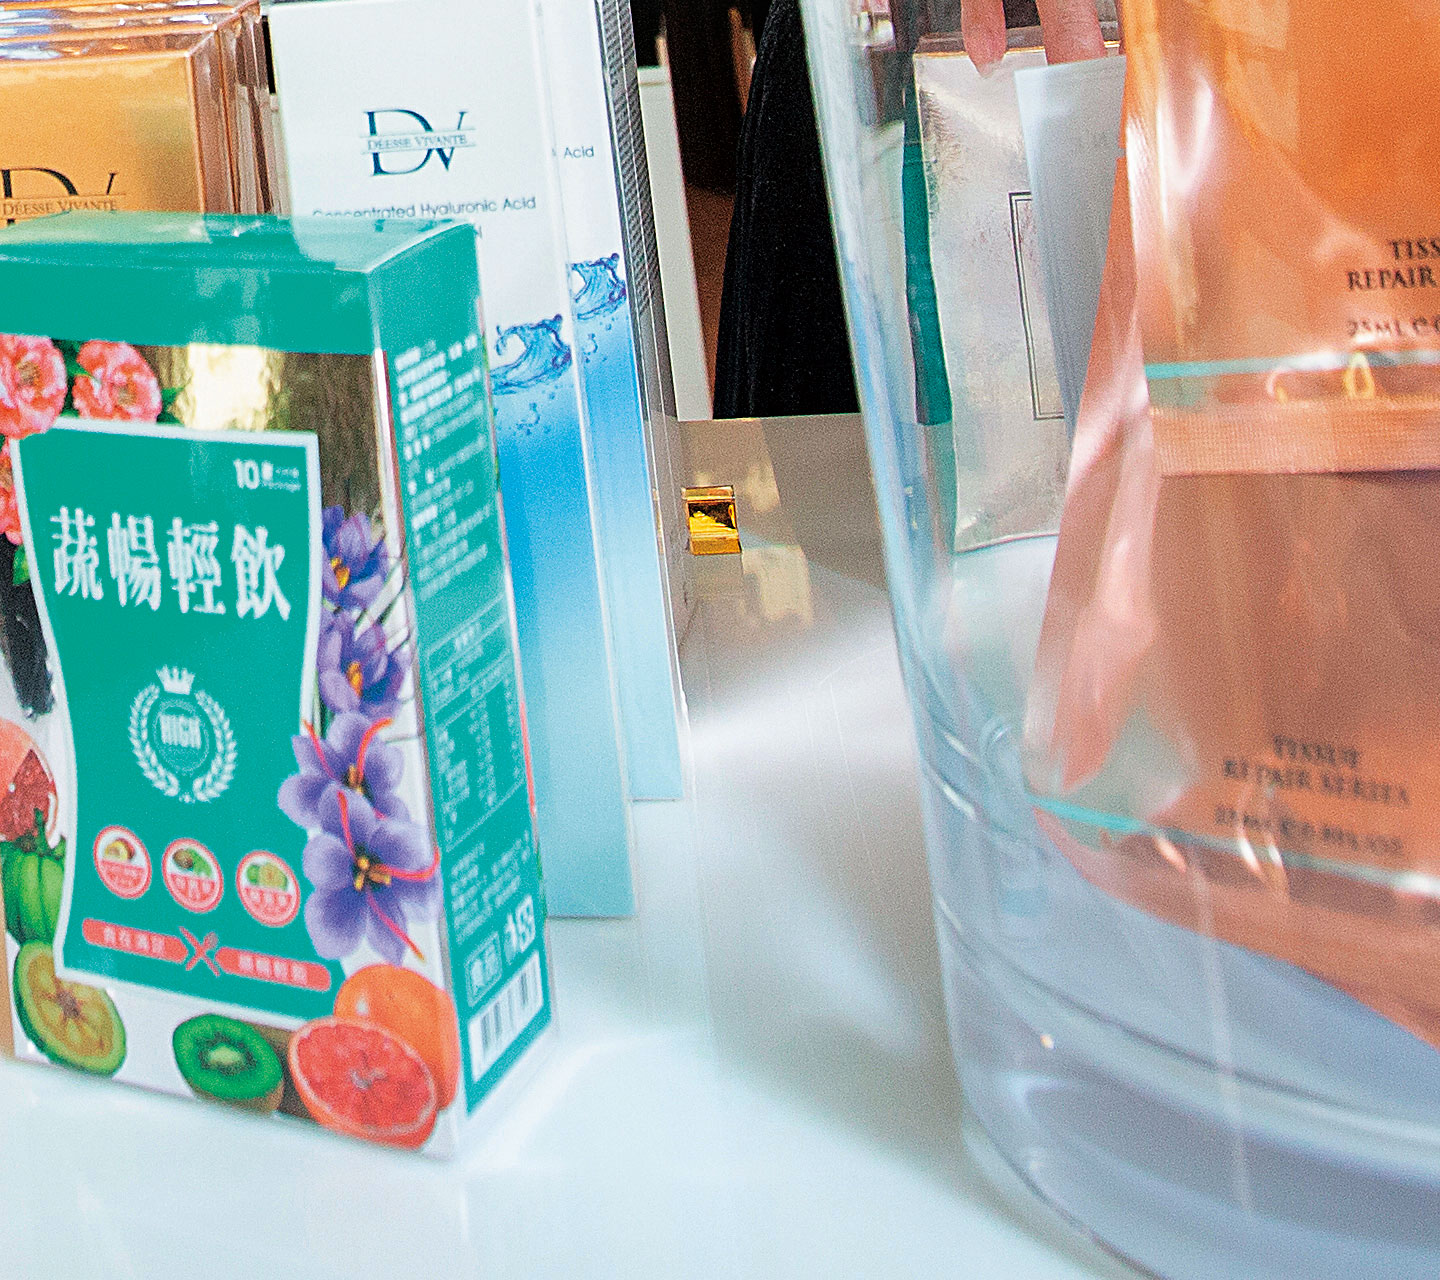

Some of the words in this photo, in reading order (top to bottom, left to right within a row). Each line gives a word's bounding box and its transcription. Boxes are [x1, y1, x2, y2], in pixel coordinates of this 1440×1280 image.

[363, 109, 468, 177] DV
[563, 146, 595, 159] Acid
[420, 199, 498, 220] Hyaluronic
[503, 196, 537, 211] Acid
[1346, 265, 1438, 291] REPAIR
[233, 458, 261, 490] 10
[50, 505, 292, 622] 蔬暢輕飲
